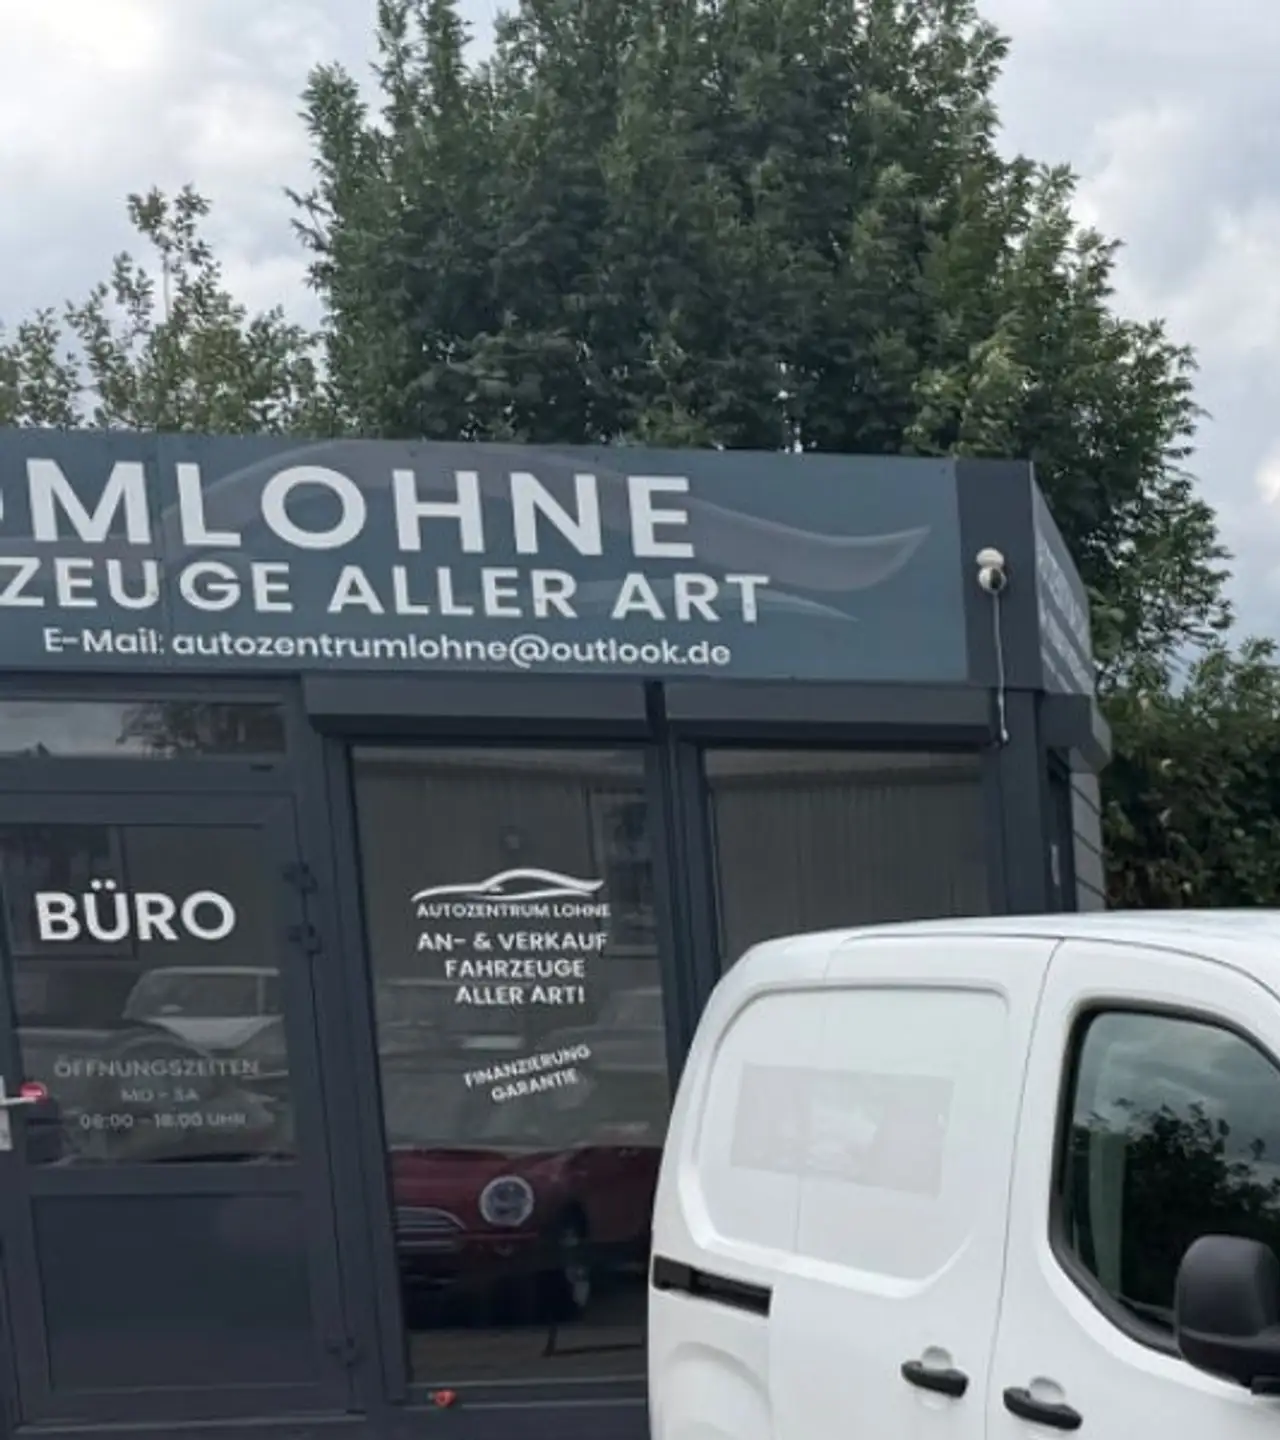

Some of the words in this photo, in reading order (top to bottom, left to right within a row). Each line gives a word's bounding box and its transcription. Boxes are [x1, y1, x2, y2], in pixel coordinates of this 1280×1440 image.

[0, 457, 695, 558] MLOHNE
[328, 564, 577, 619] ALLER
[611, 572, 769, 624] ART
[43, 627, 165, 656] E-Mail:
[172, 632, 731, 668] autozentrumlohne@outlook.de
[35, 879, 236, 942] BÜRO
[417, 903, 549, 918] AUTOZENTRUM
[553, 902, 611, 918] LOHNE
[417, 932, 466, 951] AN-
[473, 932, 492, 951] &
[497, 932, 609, 950] VERKAUF
[445, 959, 586, 978] FAHRZEUGE
[455, 985, 523, 1005] ALLER
[463, 1044, 591, 1088] FINANZIERUNG
[491, 1067, 579, 1103] GARANTIE
